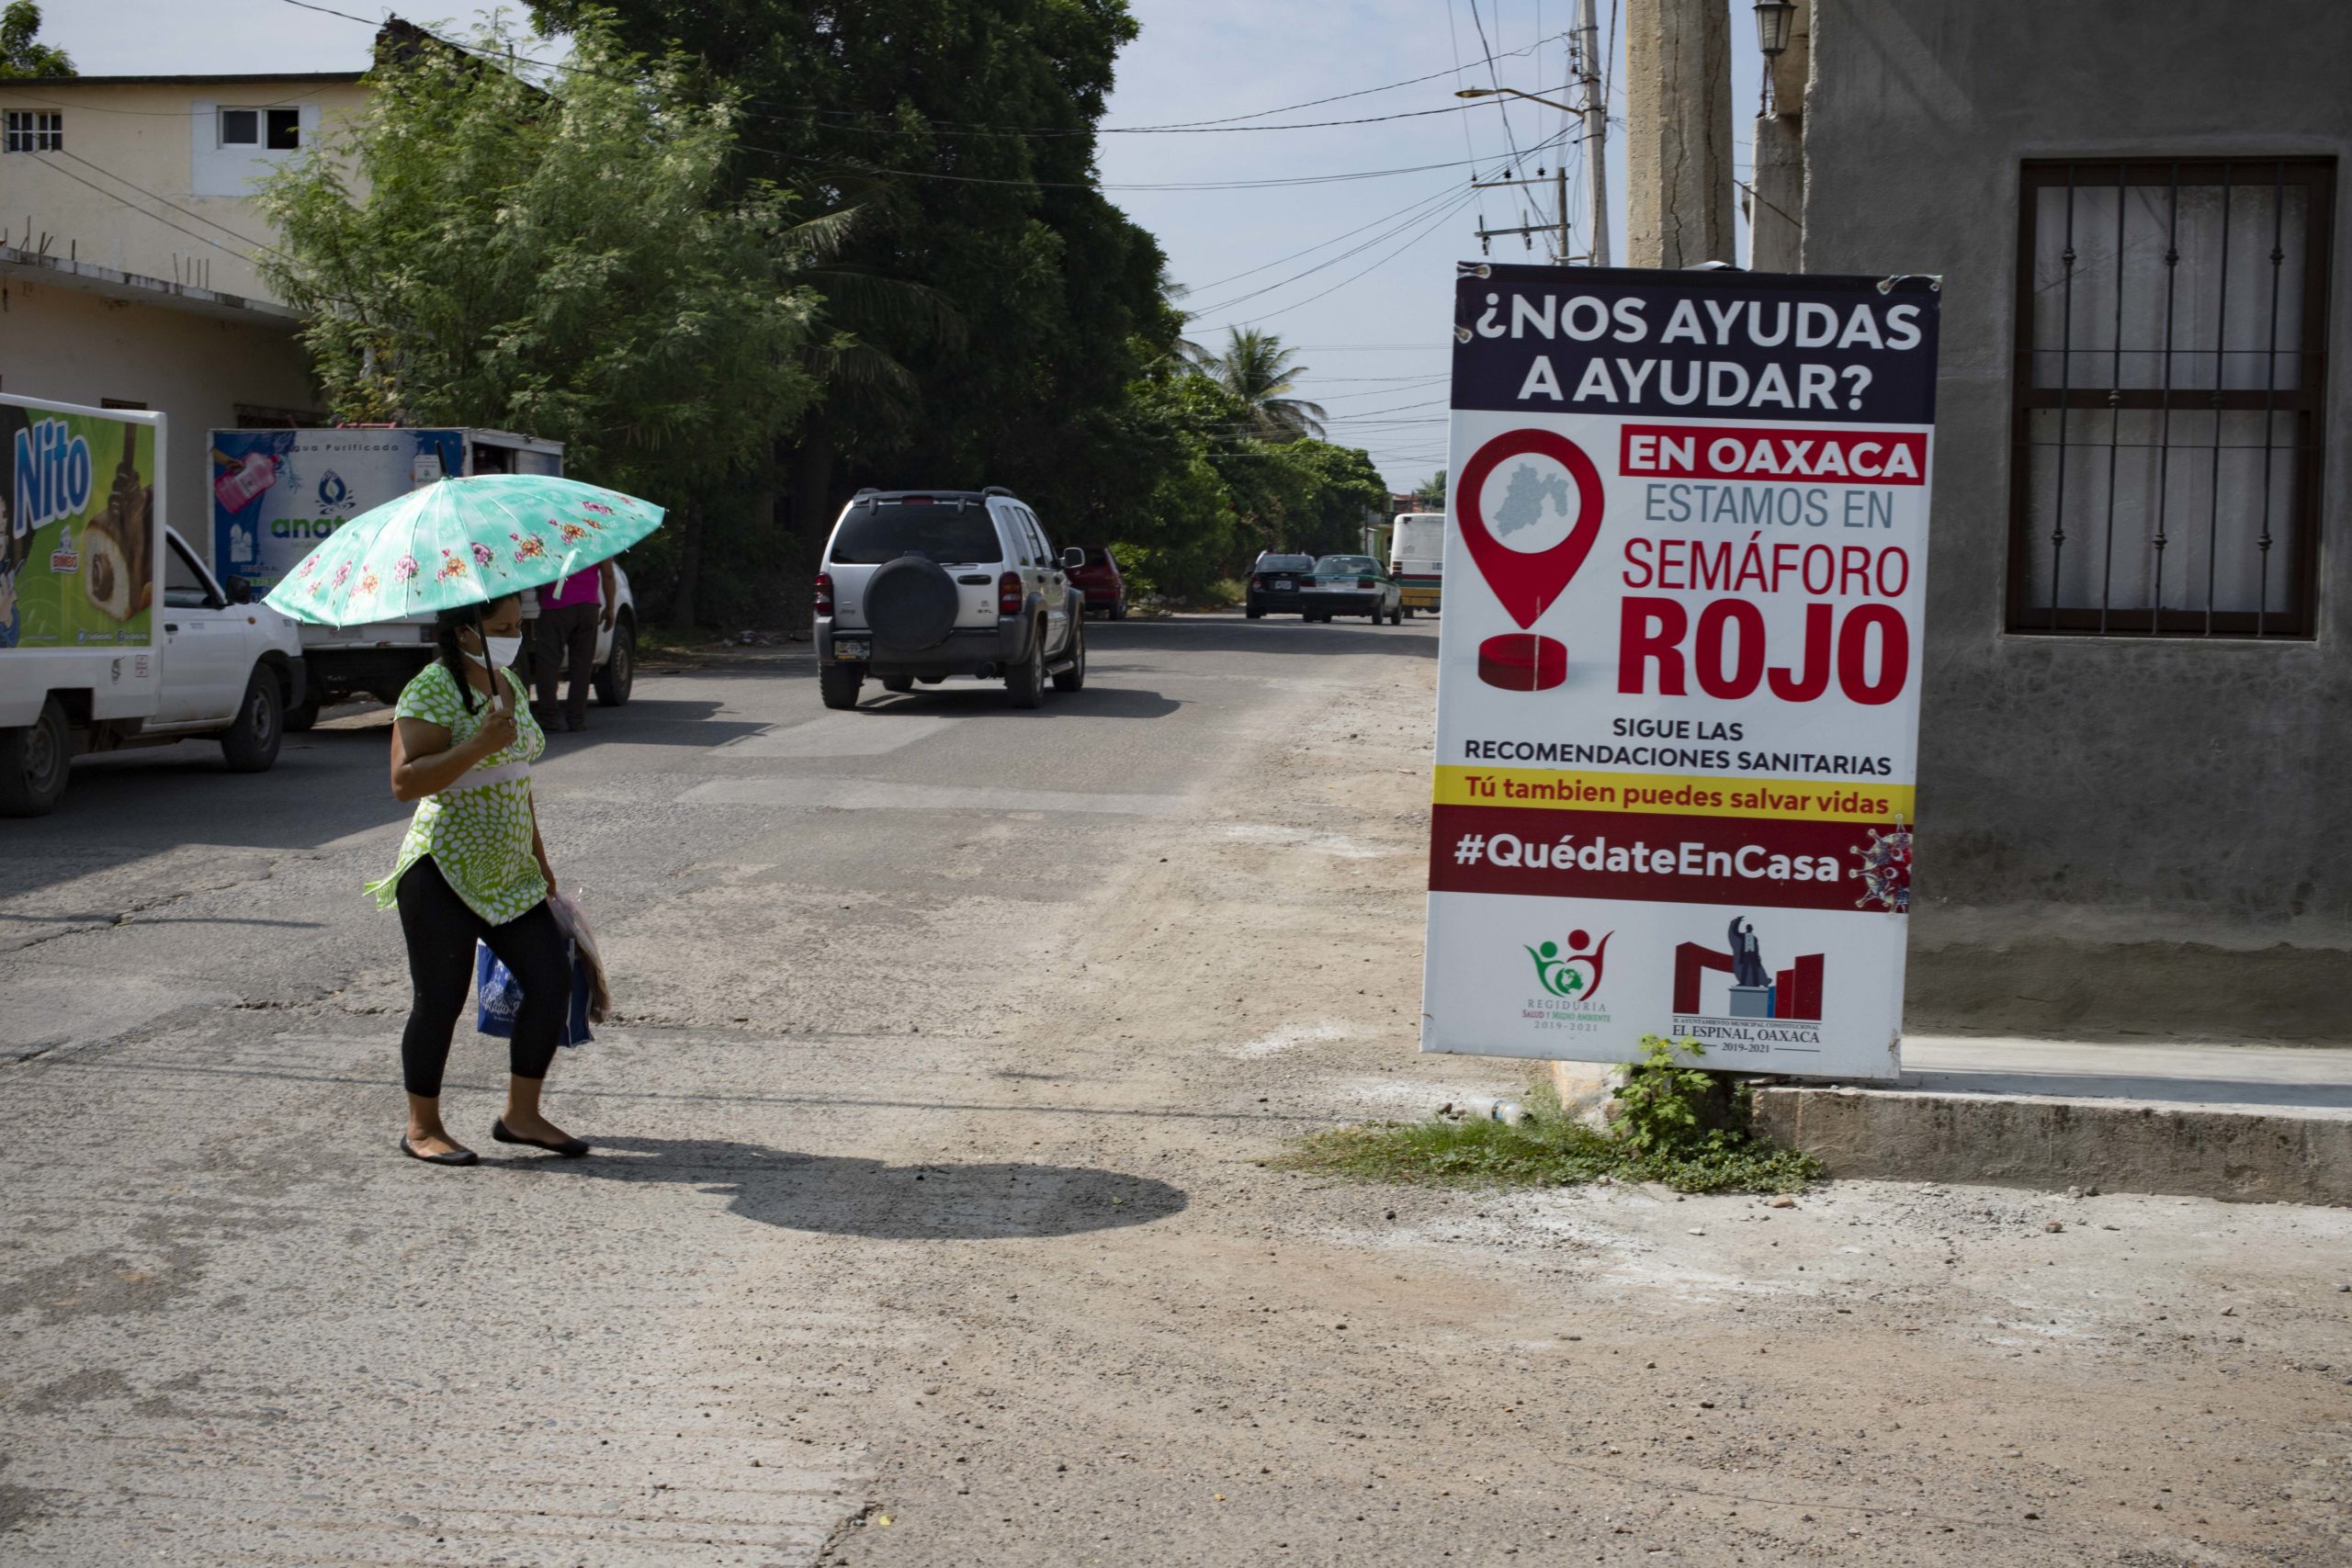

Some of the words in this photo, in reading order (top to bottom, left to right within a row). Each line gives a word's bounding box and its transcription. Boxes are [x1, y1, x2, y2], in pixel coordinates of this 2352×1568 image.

[1476, 293, 1647, 344] ¿NOS
[1660, 299, 1922, 350] AYUDAS
[1517, 355, 1563, 400] A
[1572, 357, 1872, 411] AYUDAR?
[285, 444, 318, 453] gua
[1629, 434, 1695, 471] EN
[1708, 438, 1919, 479] OAXACA
[14, 417, 91, 535] Nito
[1645, 484, 1828, 527] ESTAMOS
[1843, 491, 1893, 528] EN
[1623, 531, 1909, 597] SEMÁFORO
[1618, 596, 1909, 705] ROJO
[1613, 717, 1690, 739] SIGUE
[1698, 721, 1744, 740] LAS
[1464, 739, 1730, 769] RECOMENDACIONES
[1737, 750, 1892, 775] SANITARIAS
[1465, 776, 1496, 797] Tú
[1504, 779, 1615, 802] tambien
[1623, 785, 1723, 808] puedes
[1730, 787, 1811, 811] salvar
[1816, 791, 1889, 814] vidas
[1453, 833, 1840, 882] #QuédateEnCasa
[1533, 1021, 1597, 1032] 2019-2021
[1673, 1025, 1691, 1035] EL
[1692, 1027, 1755, 1042] ESPINAL,
[1758, 1030, 1820, 1043] OAXACA
[1722, 1043, 1770, 1053] 2019-2021
